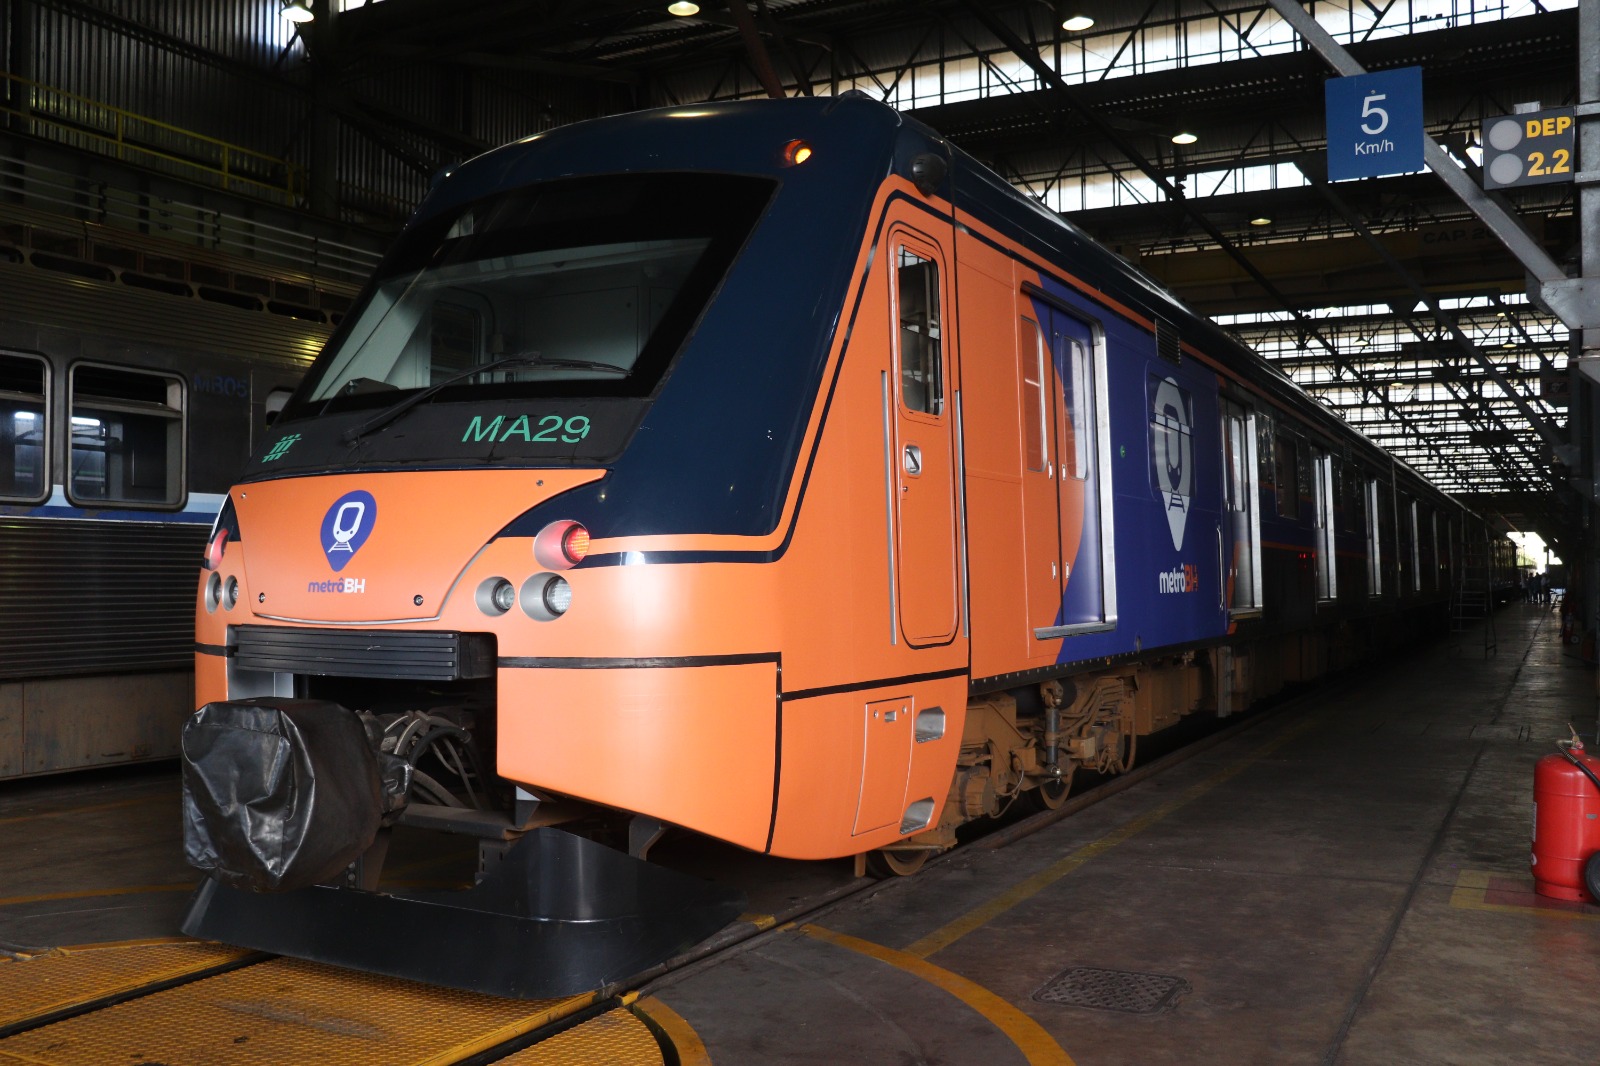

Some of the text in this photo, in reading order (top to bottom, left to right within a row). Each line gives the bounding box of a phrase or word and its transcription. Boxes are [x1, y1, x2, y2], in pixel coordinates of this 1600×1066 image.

[1361, 94, 1389, 135] 5
[1526, 116, 1572, 138] DEP
[1355, 139, 1394, 156] Km/h
[1528, 149, 1571, 177] 2.2
[461, 415, 590, 443] MA29
[307, 577, 366, 594] metrôBH
